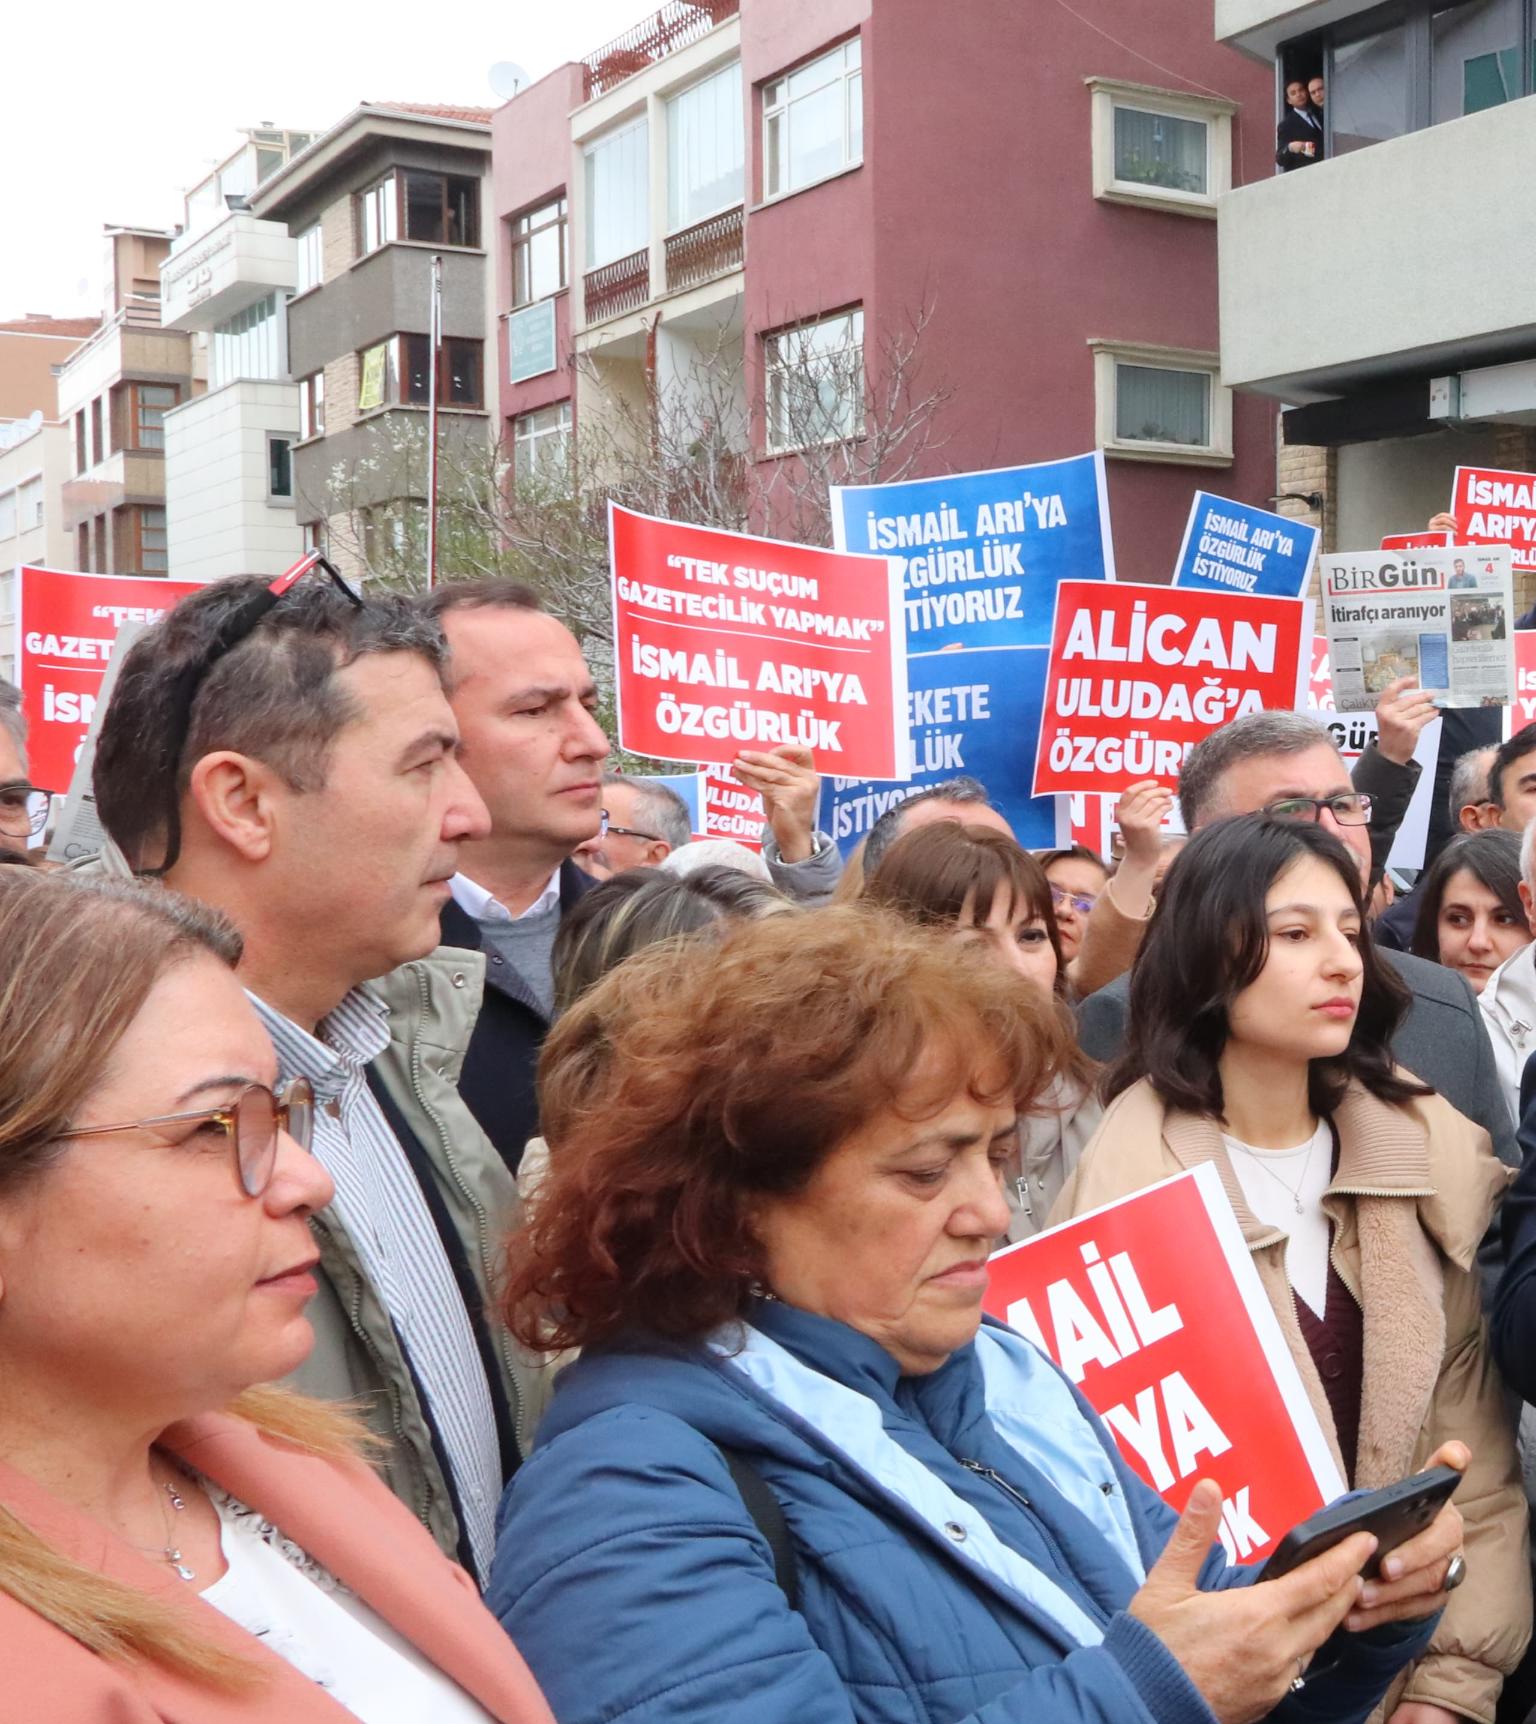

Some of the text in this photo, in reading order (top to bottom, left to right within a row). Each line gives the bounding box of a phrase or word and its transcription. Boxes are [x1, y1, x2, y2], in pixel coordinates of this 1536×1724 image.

[867, 491, 1067, 550] İSMAİL ARI'YA
[1204, 508, 1294, 557] İSMAİL ARI'YA
[901, 539, 1025, 591] ZGÜRLÜK
[1192, 553, 1258, 593] İSTİYORUZ
[1199, 531, 1267, 572] ÖZGÜRLÜK
[667, 554, 819, 601] "TEK SUÇUM
[617, 576, 886, 641] GAZETECİLİK YAPMAK"
[904, 586, 1025, 632] TİYORUZ
[1331, 604, 1447, 625] İtirafçı aranıyor
[25, 631, 115, 660] GAZET
[1061, 600, 1277, 674] ALİCAN
[632, 634, 868, 706] İSMAİL ARI'YA
[655, 692, 843, 752] ÖZGÜRLÜK
[908, 684, 991, 727] KETE
[1055, 677, 1265, 725] ULUDAĞ'A
[1049, 727, 1196, 777] ÖZGÜR
